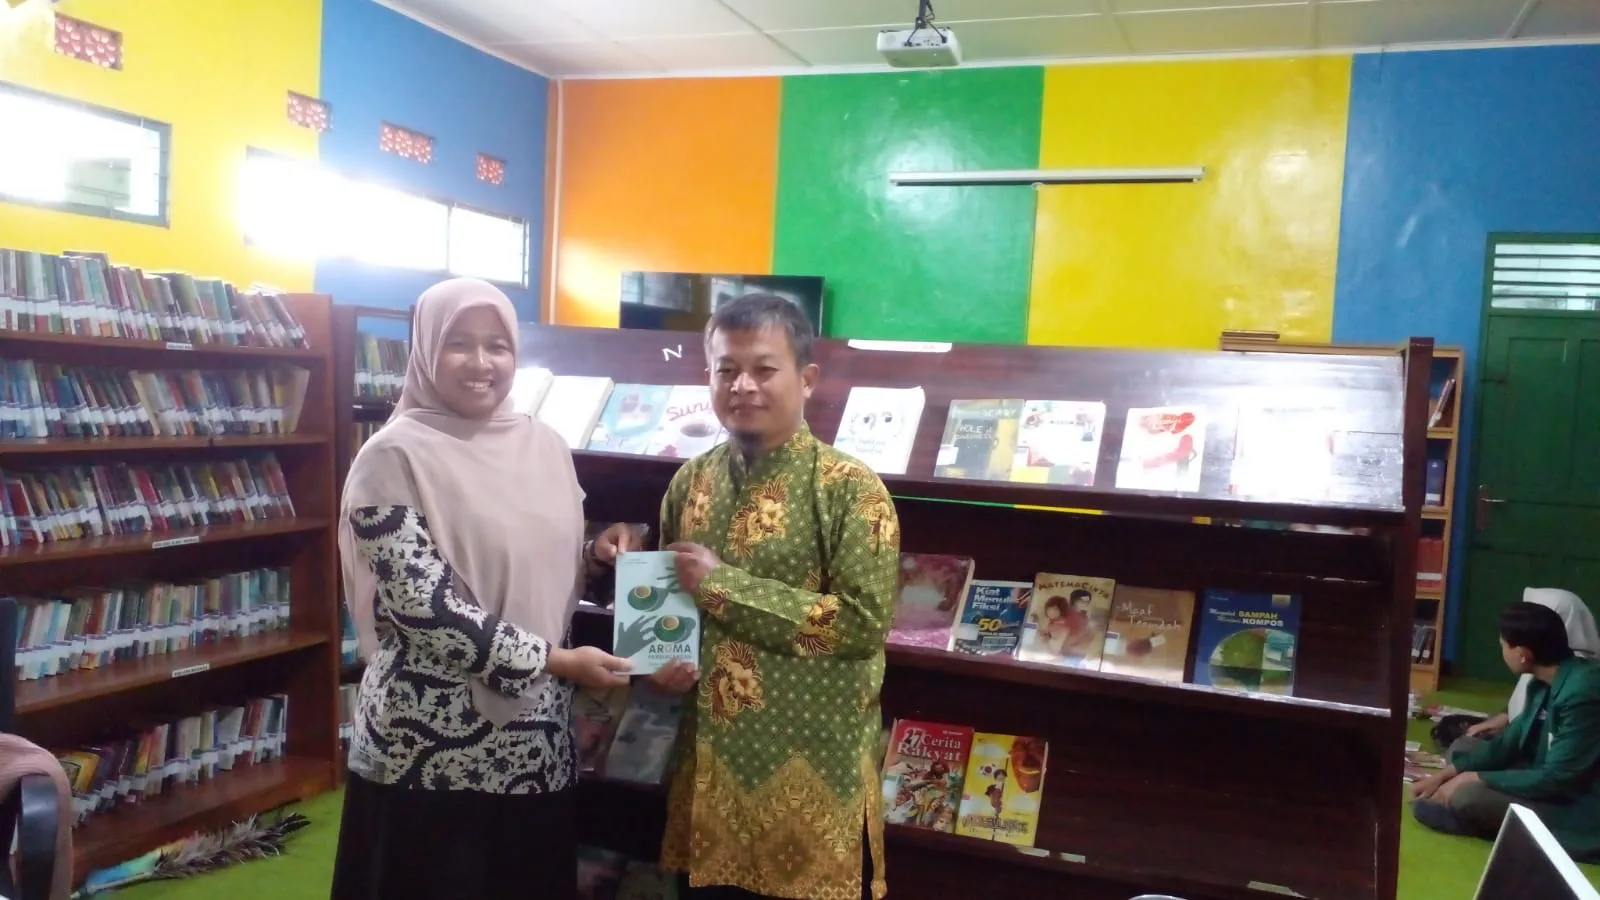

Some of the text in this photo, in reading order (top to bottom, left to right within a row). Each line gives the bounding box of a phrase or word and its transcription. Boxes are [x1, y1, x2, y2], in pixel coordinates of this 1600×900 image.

[975, 586, 1001, 596] Kiat
[971, 601, 1001, 611] Fiksi
[1238, 610, 1279, 620] SAMPAH
[978, 618, 1003, 632] 50
[1242, 618, 1284, 627] KOMPOS
[648, 643, 692, 654] AROMA
[903, 728, 961, 749] 27 Cerita
[897, 742, 961, 762] Rakyat
